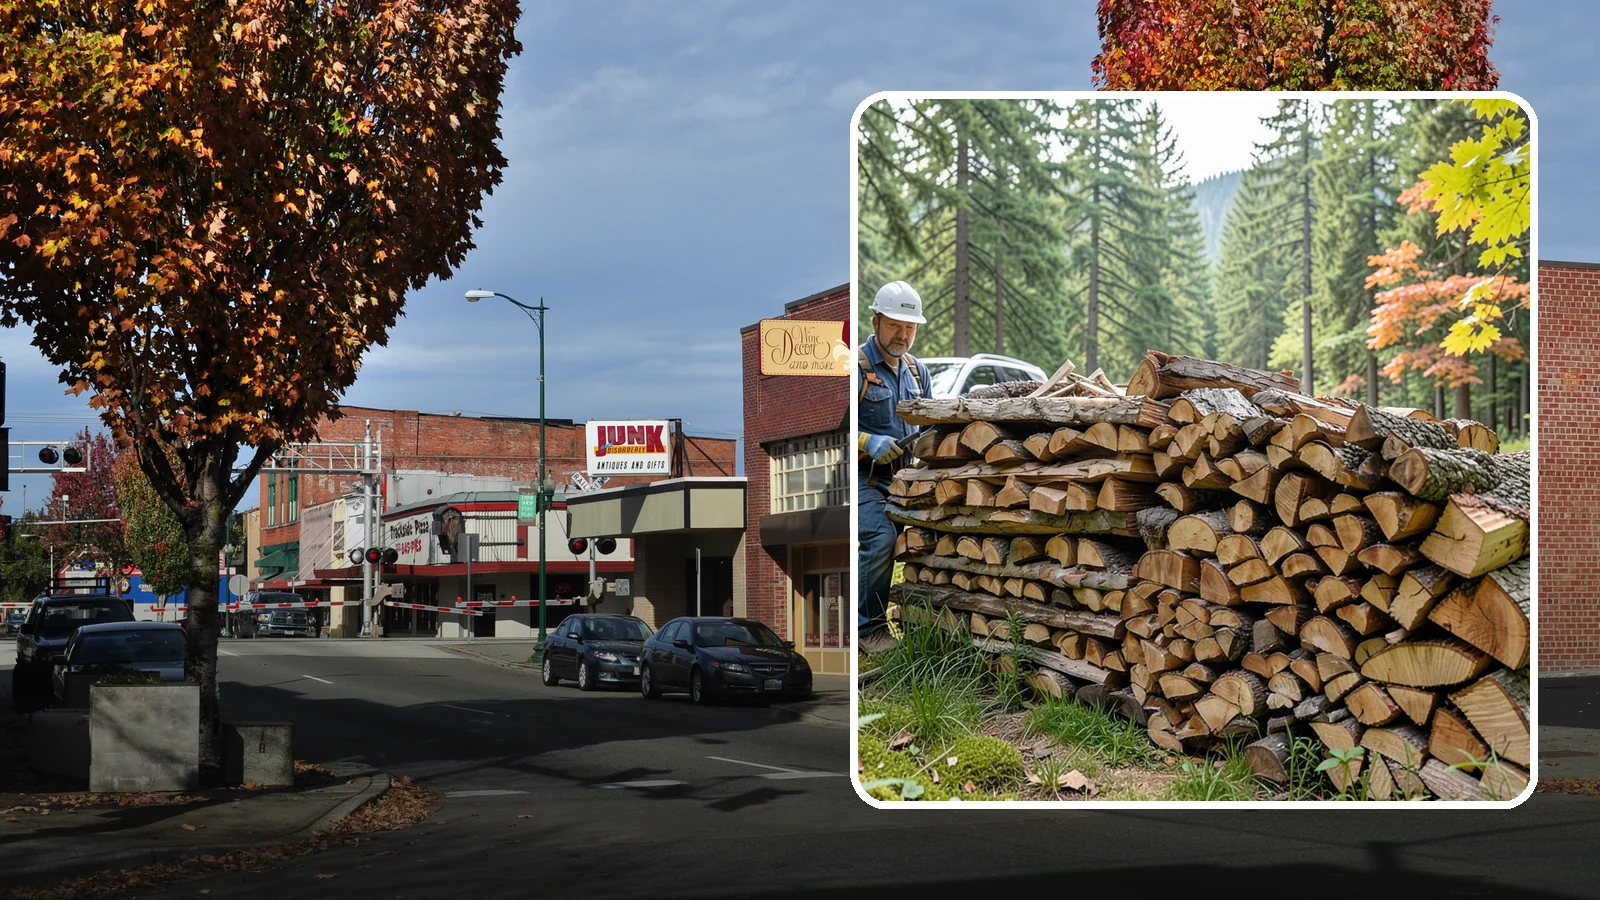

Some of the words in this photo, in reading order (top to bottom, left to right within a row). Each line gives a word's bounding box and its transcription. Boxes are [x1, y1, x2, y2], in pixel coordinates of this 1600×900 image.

[595, 425, 665, 457] JUNK
[607, 446, 646, 454] DISORDERLY
[596, 461, 628, 470] ANTIQUES
[631, 461, 644, 470] AND
[647, 461, 665, 470] GIFTS
[414, 519, 429, 535] Pizza
